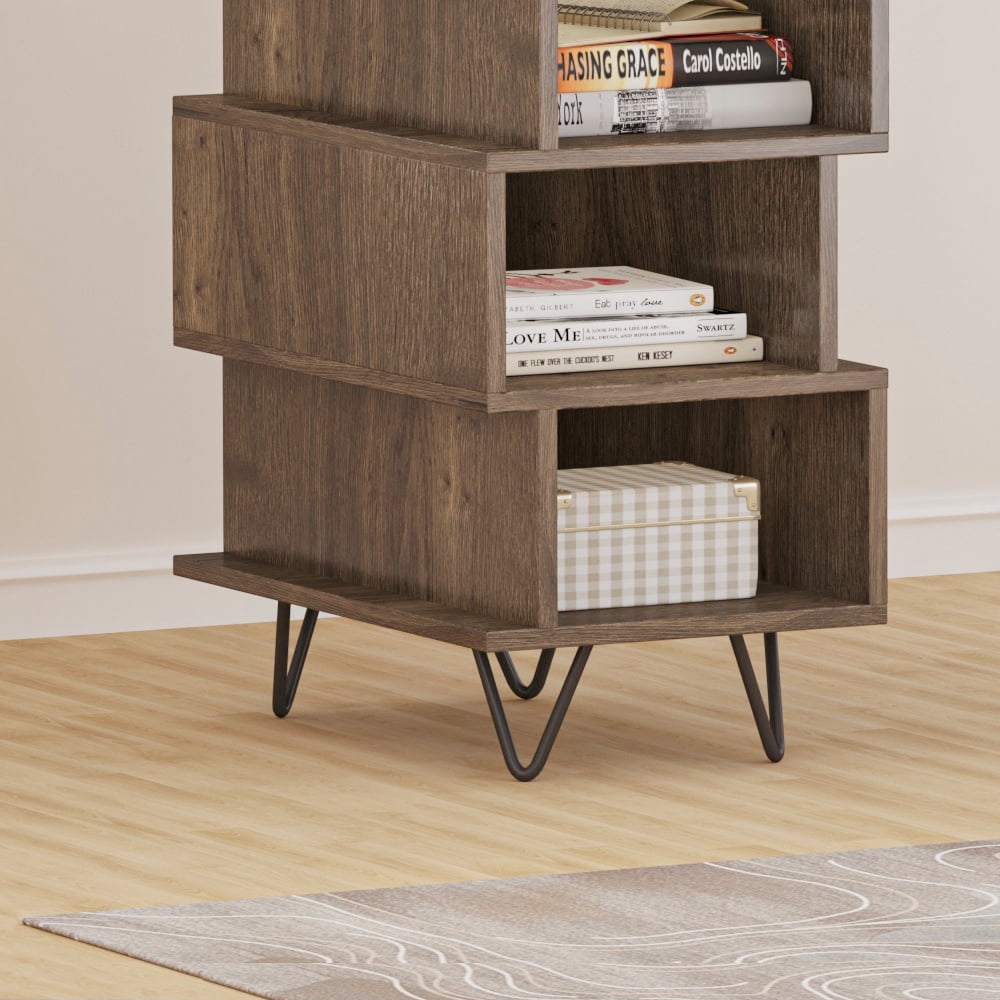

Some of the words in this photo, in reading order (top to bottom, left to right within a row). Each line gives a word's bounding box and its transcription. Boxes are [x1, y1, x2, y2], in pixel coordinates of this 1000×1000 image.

[616, 47, 666, 79] GRACE
[683, 47, 713, 74] Carol
[716, 45, 761, 72] Costello
[595, 299, 611, 309] Eat
[696, 323, 736, 333] SWARTZ
[518, 360, 529, 368] ONE
[531, 359, 545, 367] FLEW
[547, 358, 561, 366] OVER
[563, 357, 572, 365] THE
[601, 354, 614, 362] NEST
[637, 351, 650, 361] KEN
[653, 350, 673, 360] KESEY
